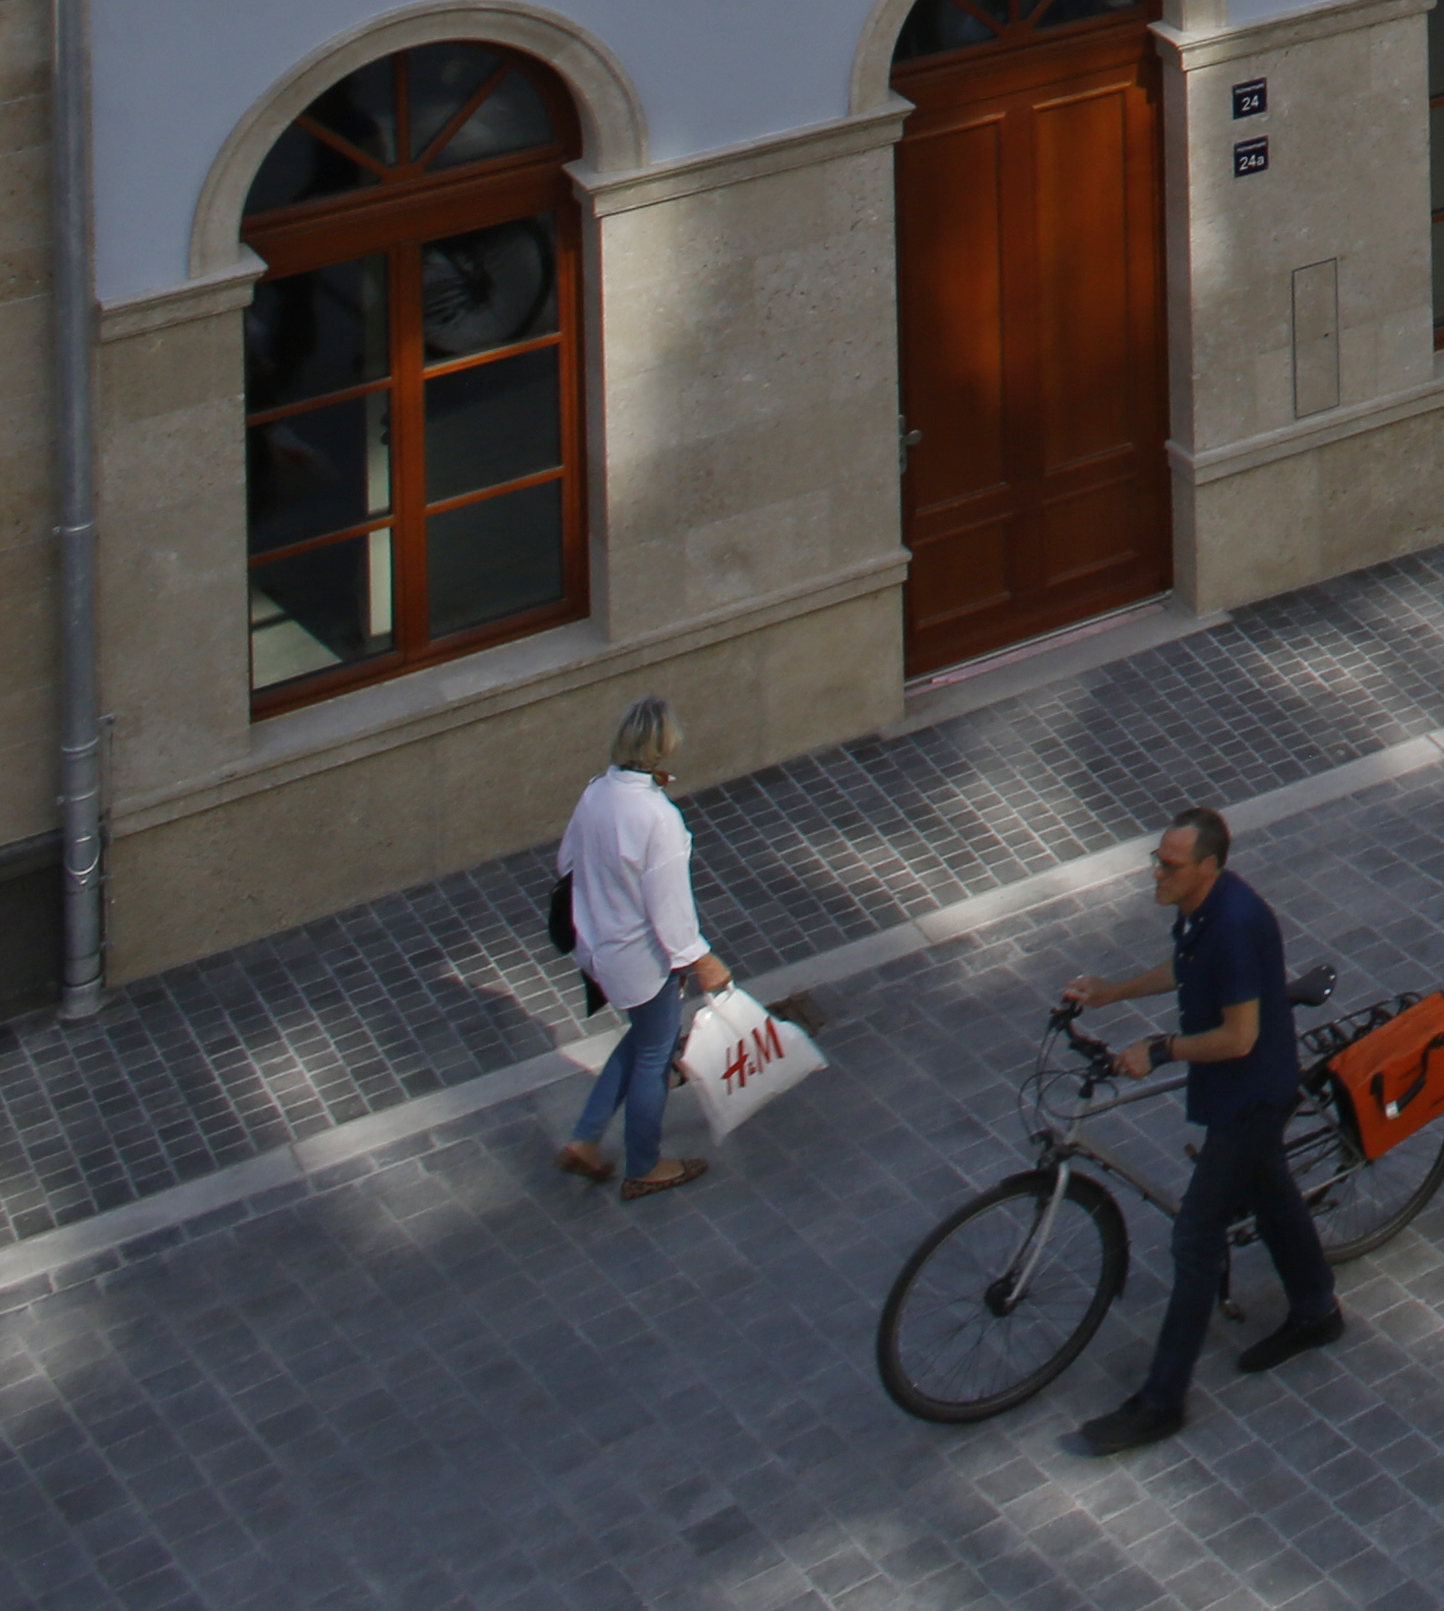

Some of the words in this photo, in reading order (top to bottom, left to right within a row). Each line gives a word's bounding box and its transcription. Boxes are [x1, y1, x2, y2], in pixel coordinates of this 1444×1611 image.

[1242, 95, 1259, 111] 24
[1239, 155, 1265, 170] 24a
[720, 1016, 785, 1096] H&M
